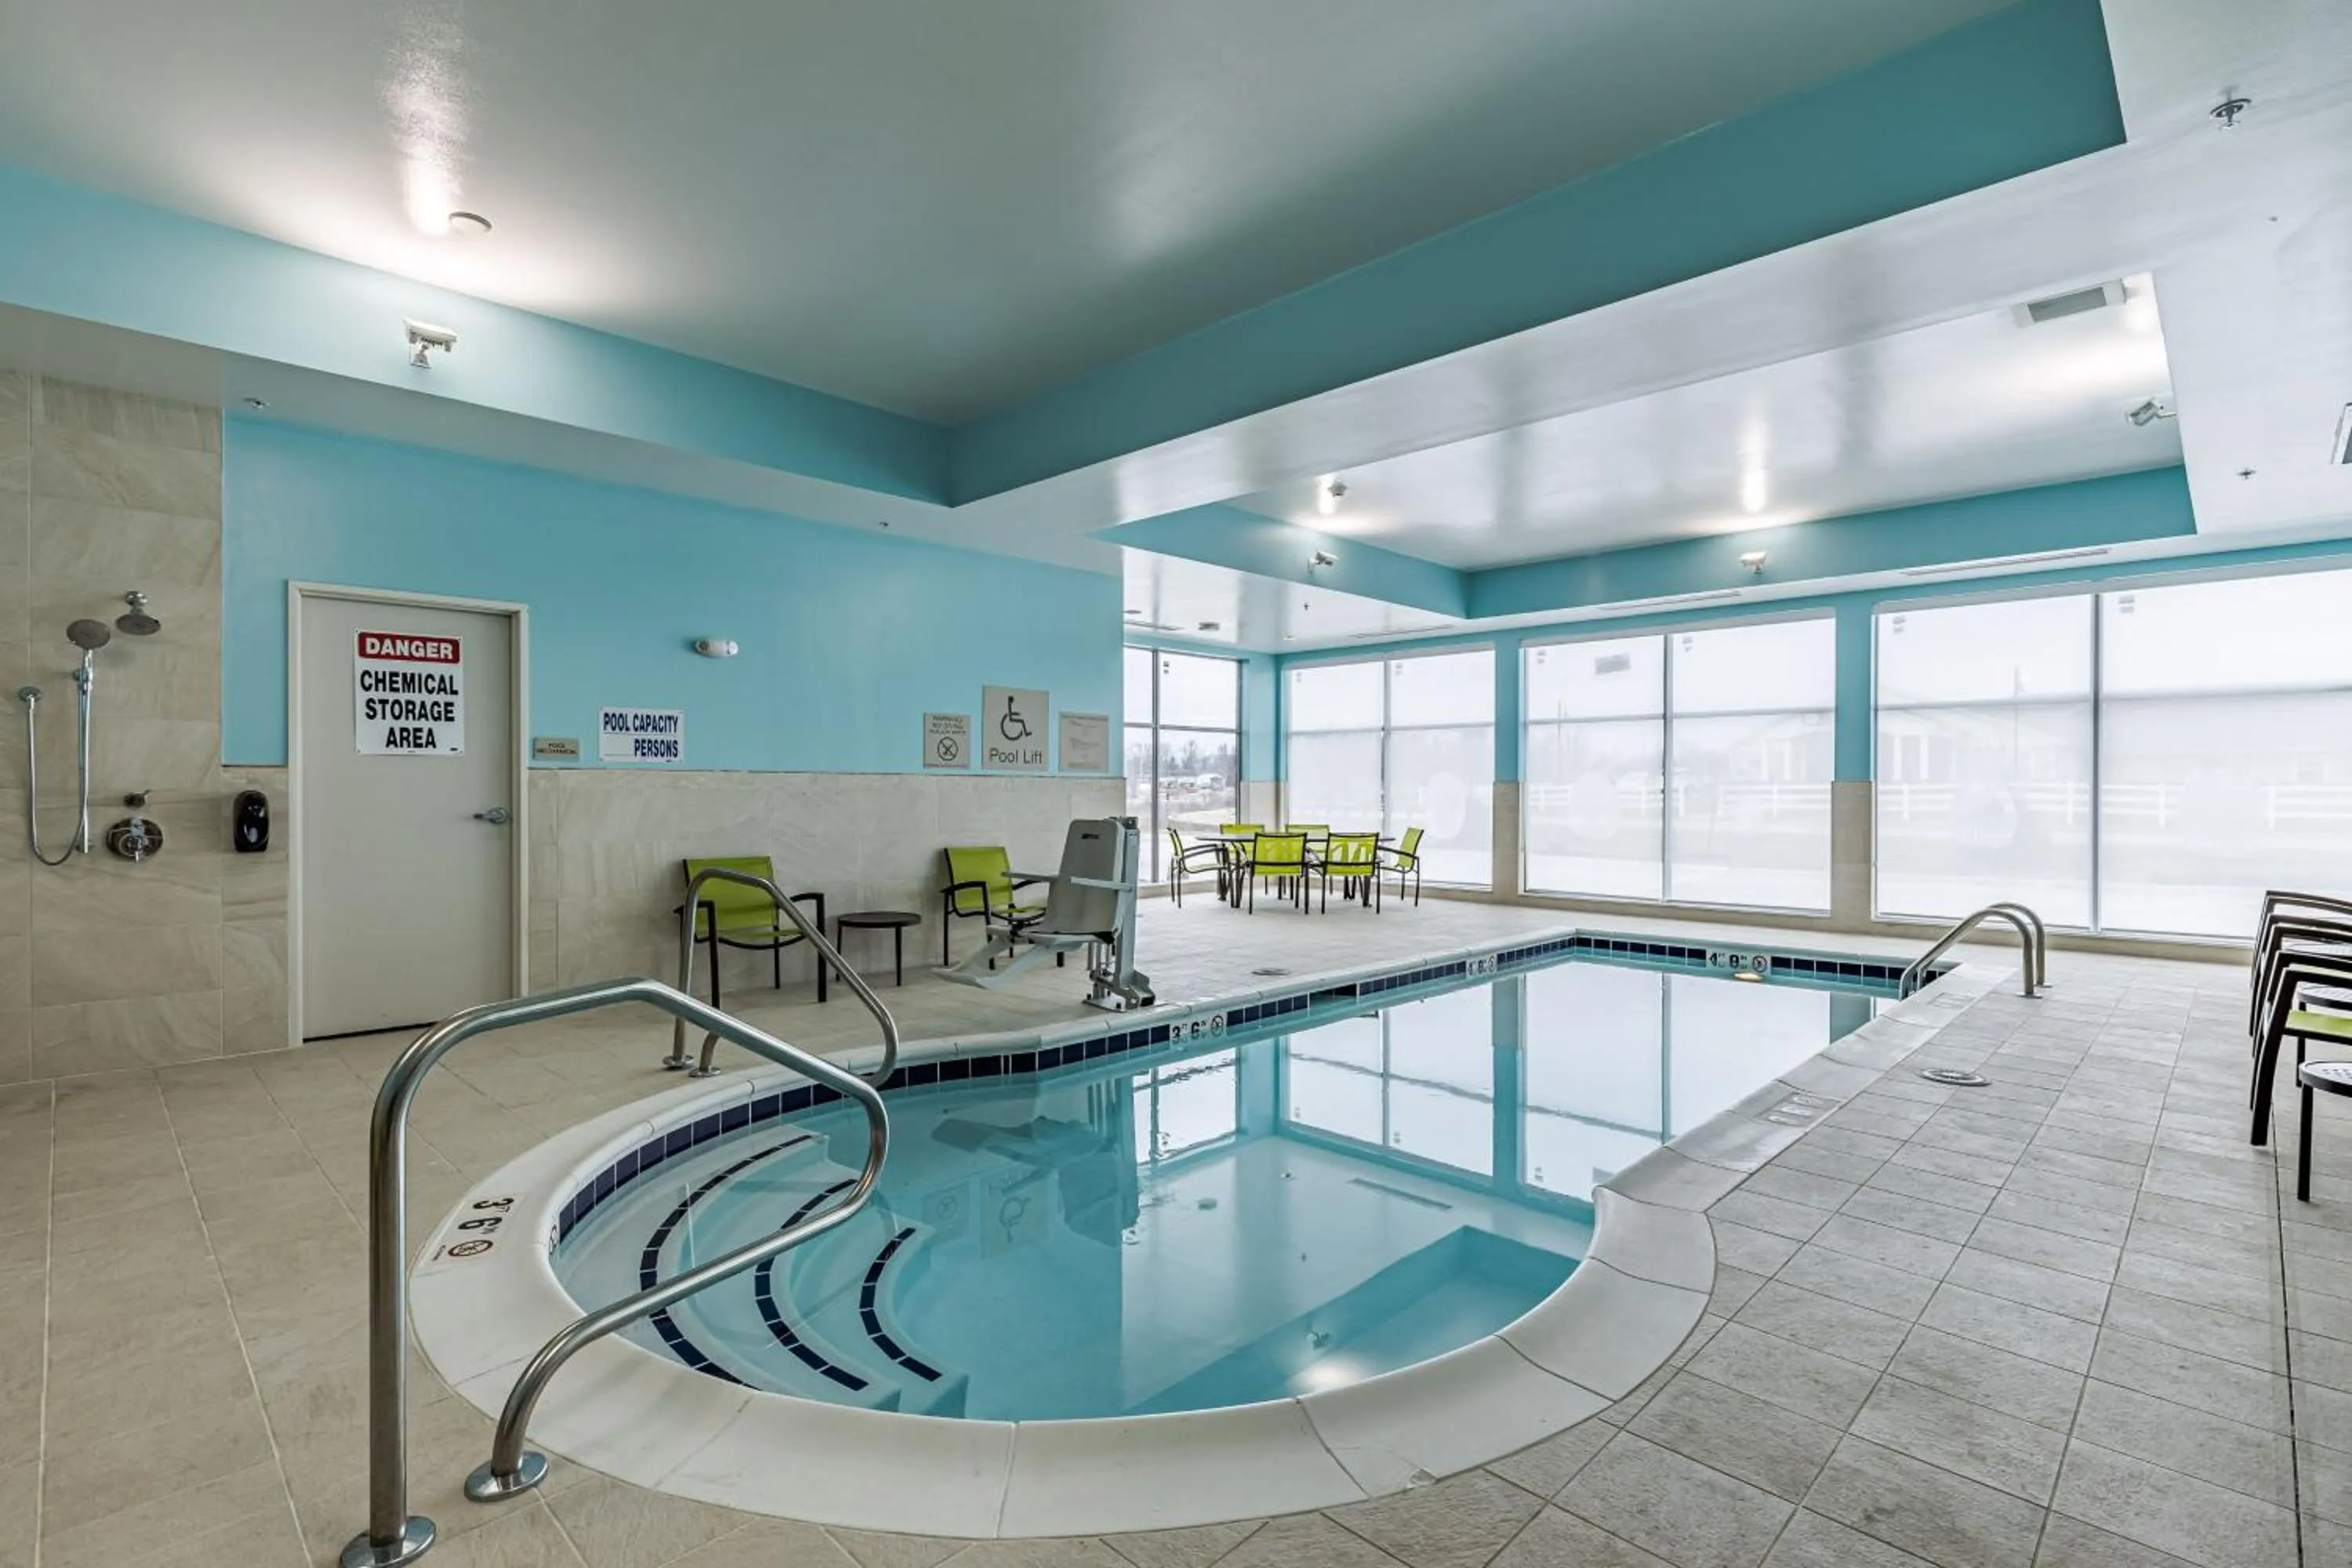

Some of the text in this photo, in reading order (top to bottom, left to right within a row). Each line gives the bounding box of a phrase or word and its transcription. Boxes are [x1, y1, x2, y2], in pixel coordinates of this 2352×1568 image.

[365, 637, 453, 659] DANGER
[360, 670, 459, 695] CHEMICAL
[365, 698, 455, 722] STORAGE
[603, 713, 678, 733] POOL CAPACITY
[386, 727, 437, 749] AREA
[634, 739, 678, 758] PERSONS
[989, 747, 1042, 764] Pool Lift
